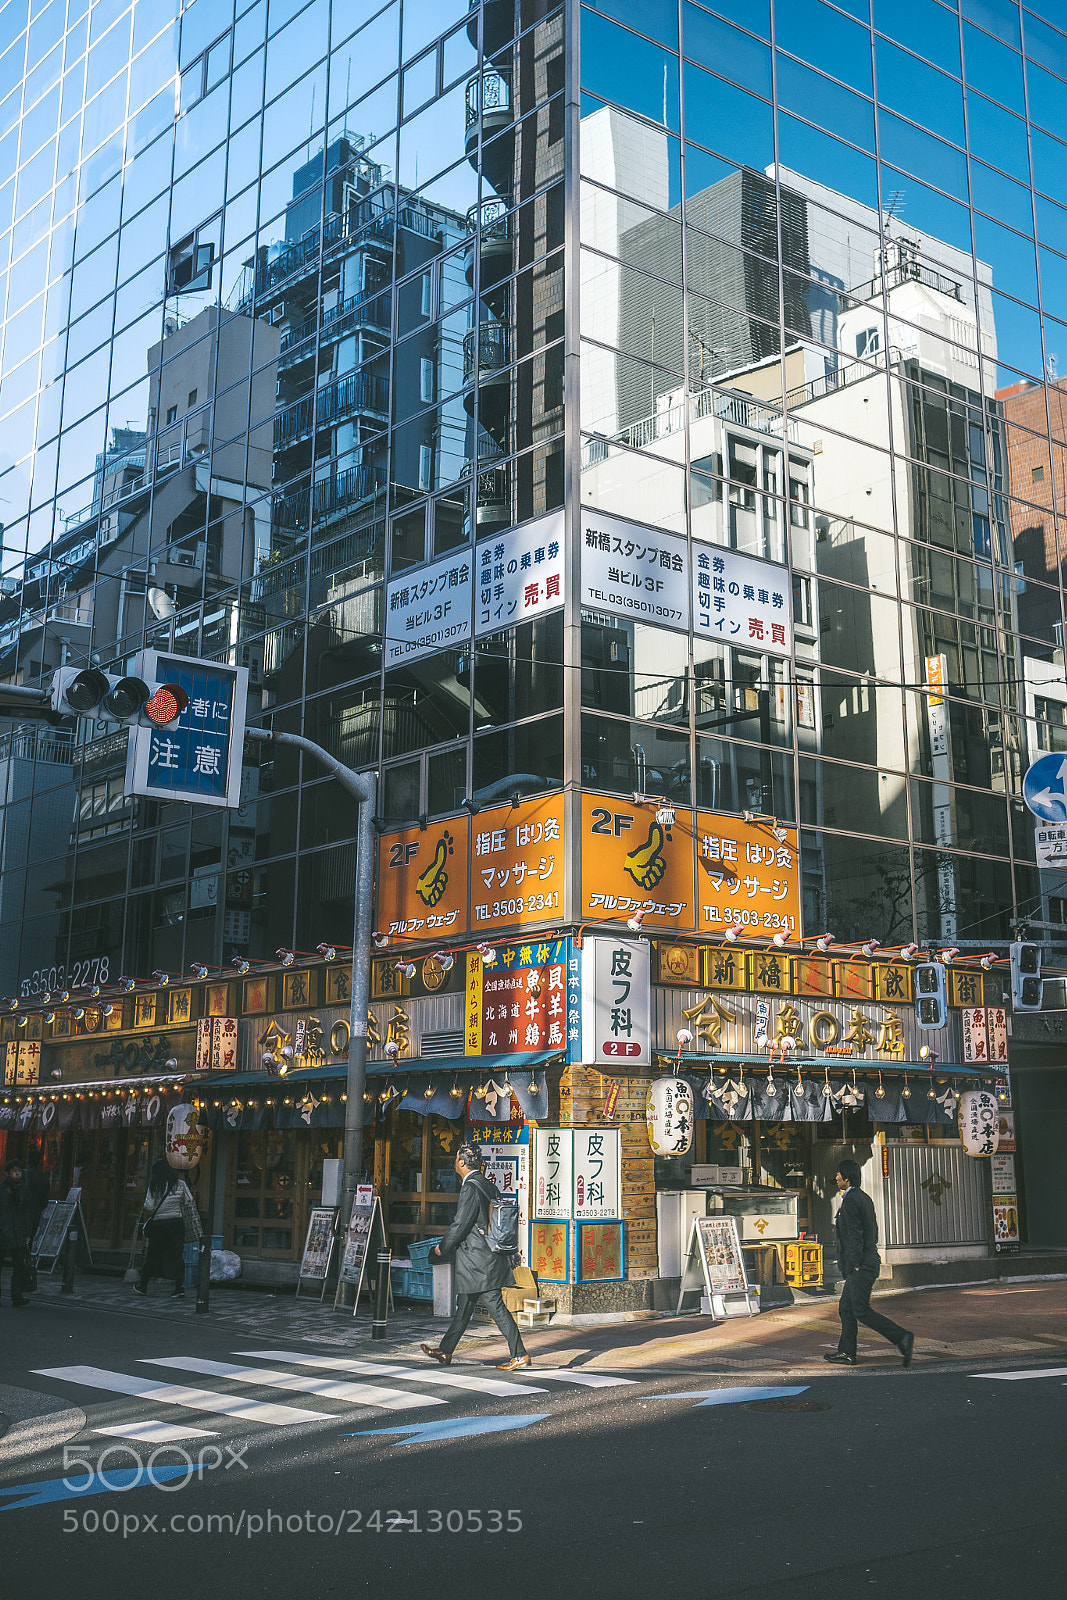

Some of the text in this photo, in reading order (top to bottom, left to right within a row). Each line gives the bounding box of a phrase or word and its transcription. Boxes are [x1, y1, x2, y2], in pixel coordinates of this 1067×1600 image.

[480, 541, 560, 586] 趣味の乗車券
[481, 543, 506, 566] 金券
[585, 528, 684, 573] 新橋スタンプ商会
[698, 552, 725, 573] 金券
[390, 563, 471, 612] 新橋スタンプ商会
[481, 583, 505, 606] 切手
[697, 572, 784, 609] 趣味の乗車券
[481, 600, 518, 626] コイン
[588, 587, 683, 621] TEL 03(3501)3077
[698, 592, 726, 613] 切手
[699, 612, 742, 635] コイン
[389, 643, 405, 658] TEL
[150, 737, 222, 776] 注意
[591, 808, 635, 837] 2F
[1038, 829, 1067, 842] 自転車
[476, 818, 561, 857] 指圧 はり灸
[1040, 842, 1067, 853] 一方
[389, 842, 420, 868] 2F
[702, 835, 793, 870] 指圧 はり灸
[480, 855, 555, 890] マッサージ
[707, 870, 789, 901] マッサージ
[475, 891, 560, 921] TEL 3503-2341
[703, 905, 796, 931] TEL 3503-2341
[567, 958, 580, 1042] 日本の祭典
[610, 948, 633, 1038] 皮フ科
[486, 1003, 521, 1021] 北海道
[489, 1029, 519, 1047] 九州
[610, 1043, 634, 1056] 2F
[472, 1125, 522, 1144] 年中無休!
[546, 1133, 562, 1206] 皮フ科
[586, 1133, 605, 1206] 皮フ科
[582, 1209, 616, 1217] 3503-2278
